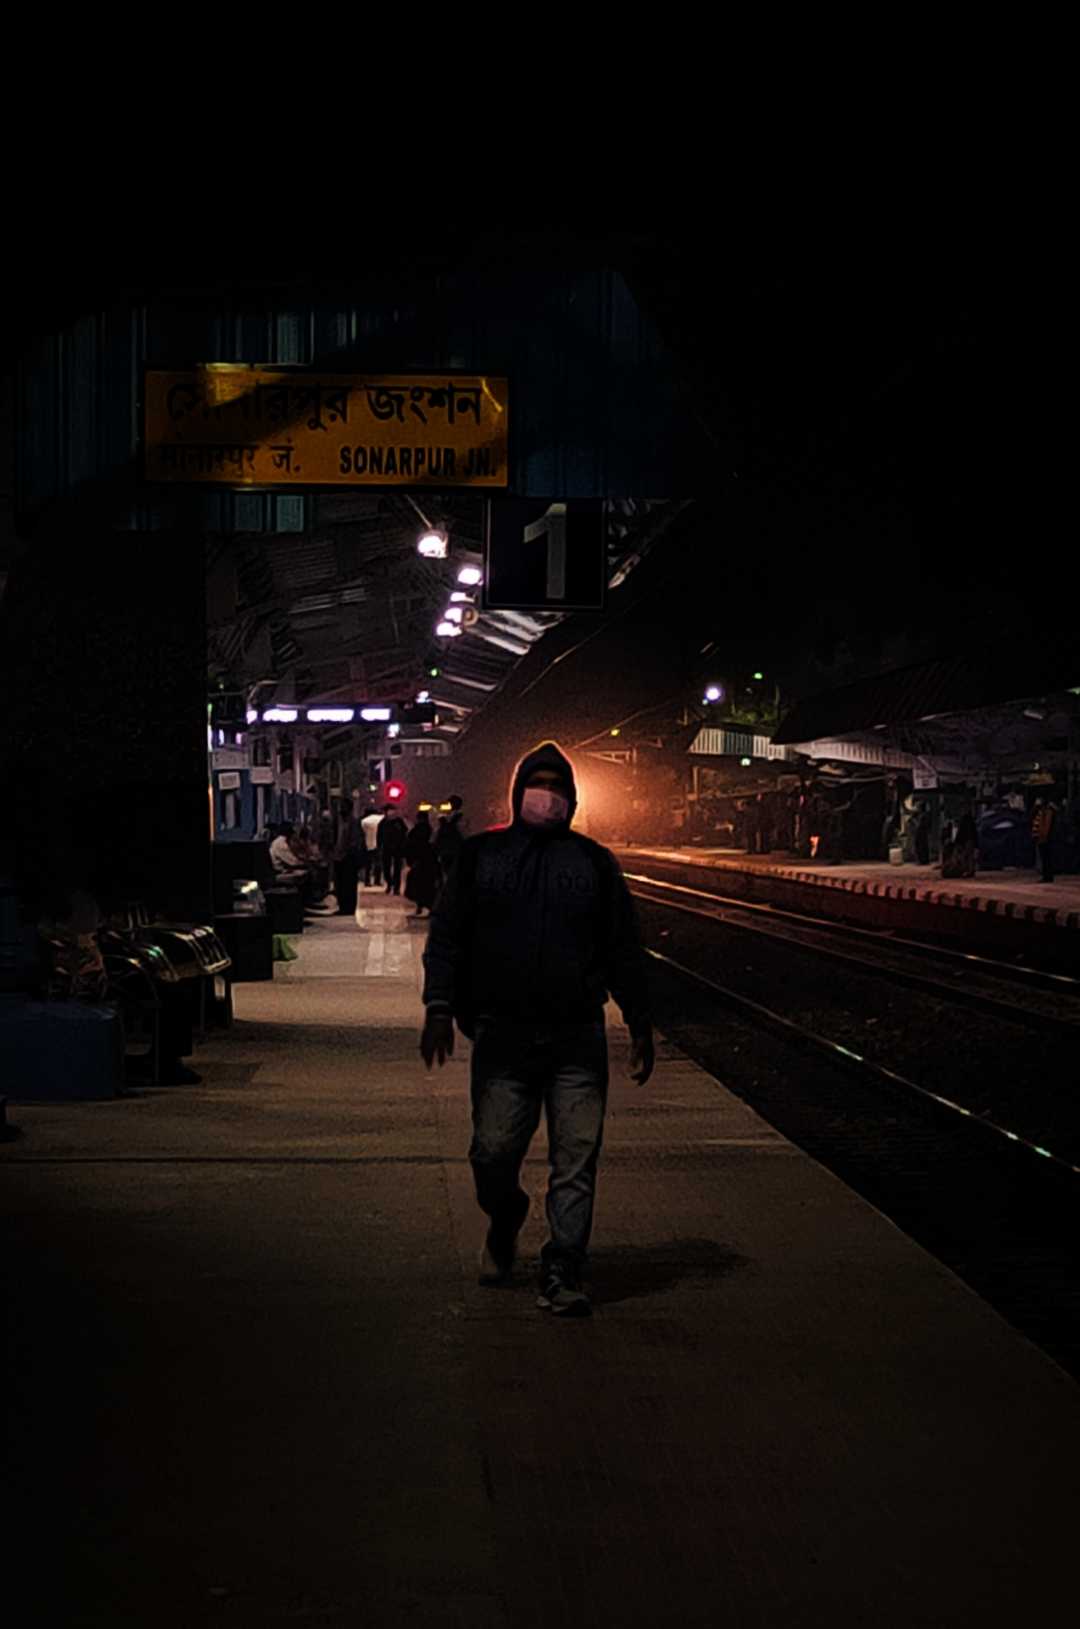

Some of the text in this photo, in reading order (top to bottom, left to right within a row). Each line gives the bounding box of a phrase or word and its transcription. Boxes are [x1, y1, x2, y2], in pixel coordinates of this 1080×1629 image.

[365, 382, 482, 425] জংশন
[340, 446, 456, 476] SONARPUR
[521, 502, 568, 600] 1
[374, 759, 386, 783] 1
